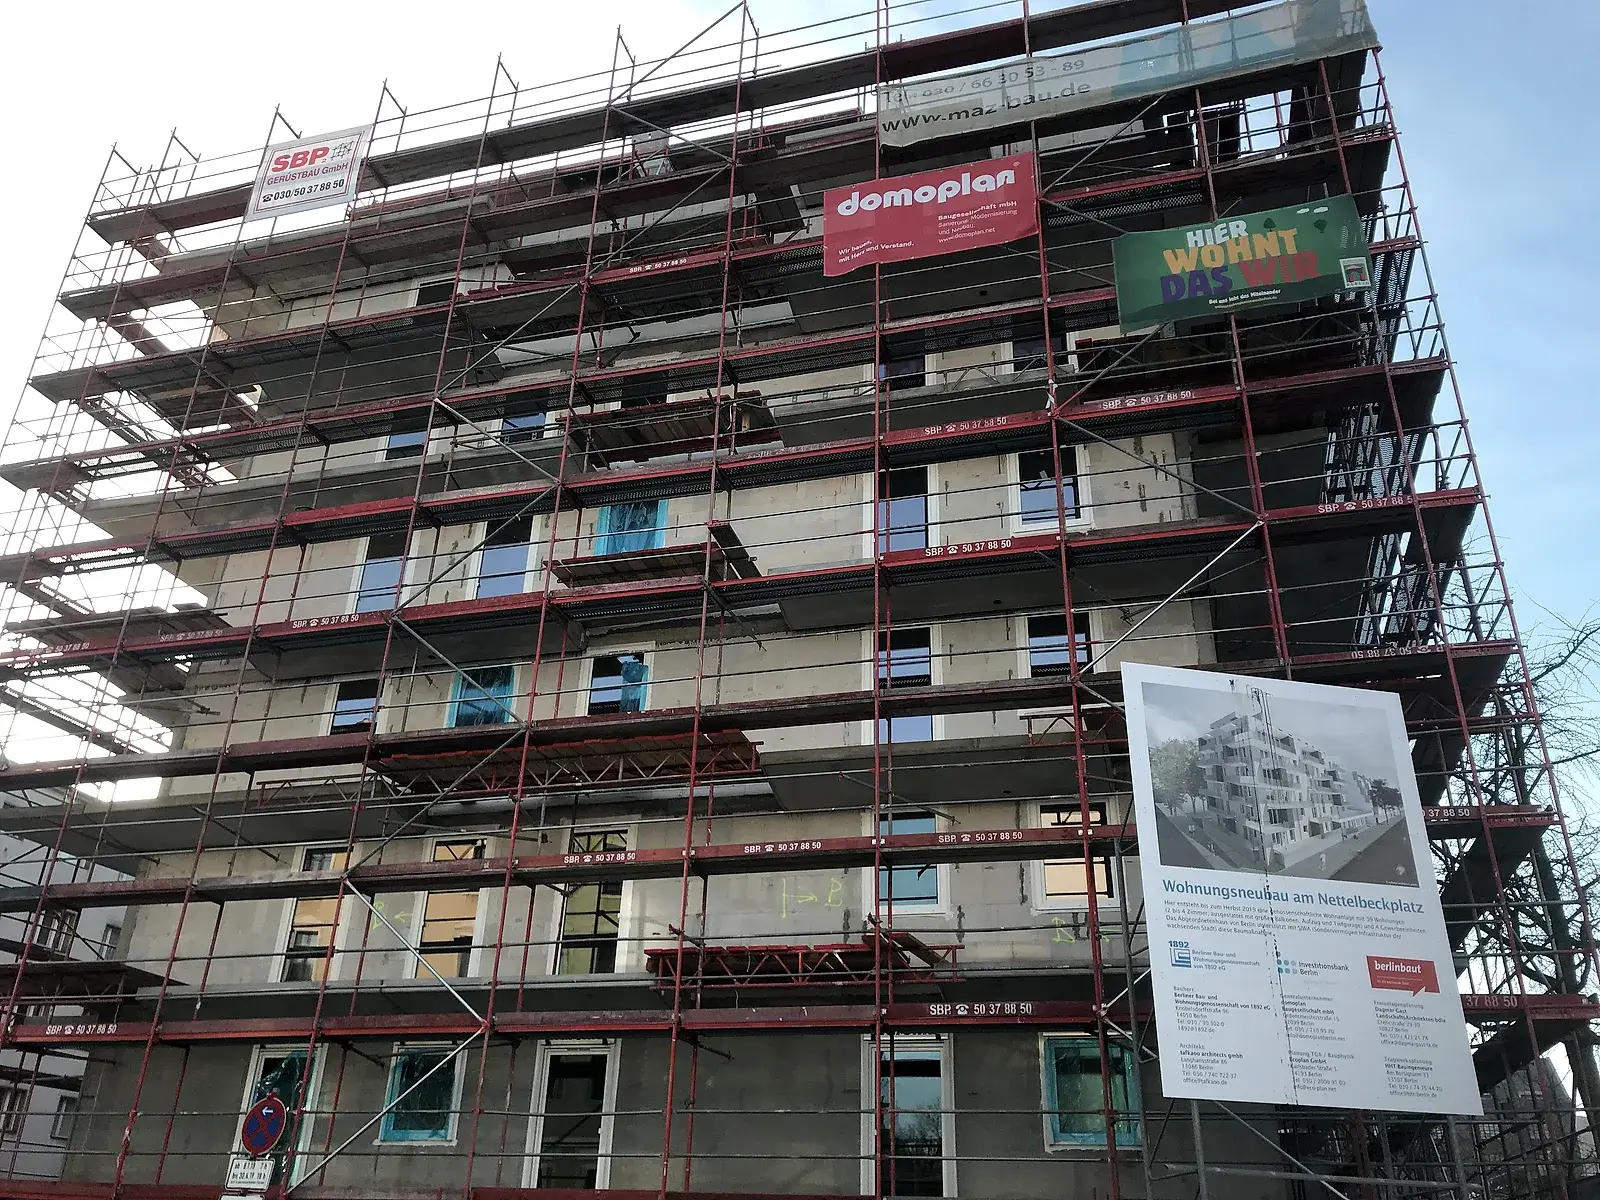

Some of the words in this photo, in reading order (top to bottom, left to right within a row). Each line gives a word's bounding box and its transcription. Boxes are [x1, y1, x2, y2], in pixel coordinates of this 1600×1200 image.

[971, 76, 993, 89] 66
[1062, 59, 1085, 72] 89
[271, 146, 330, 173] SBP
[267, 170, 320, 186] GERÜSTBAU
[321, 162, 349, 175] GmbH
[273, 187, 306, 201] 030/50
[307, 184, 319, 195] 37
[319, 181, 331, 192] 88
[333, 178, 345, 189] 50
[837, 169, 1015, 216] domoplan
[970, 209, 1018, 220] Modernisierung
[1185, 220, 1249, 248] HIER
[838, 255, 850, 263] mit
[880, 240, 915, 250] Verstand.
[1163, 228, 1298, 275] WOHNT
[1160, 265, 1233, 304] DAS
[1238, 250, 1320, 288] WIR
[1153, 394, 1164, 403] 37
[1167, 392, 1178, 401] 88
[1180, 390, 1192, 399] 50
[959, 422, 970, 431] 50
[972, 420, 982, 429] 37
[984, 419, 994, 427] 88
[996, 416, 1007, 425] 50
[1361, 499, 1373, 509] 50
[1376, 498, 1388, 507] 37
[1391, 496, 1404, 505] 88
[962, 543, 973, 553] 50
[974, 542, 986, 551] 37
[987, 541, 998, 550] 88
[1000, 539, 1012, 549] 50
[320, 618, 329, 626] 50
[330, 616, 339, 624] 37
[340, 615, 349, 623] 88
[350, 614, 359, 622] 50
[1428, 809, 1440, 817] 37
[1443, 808, 1455, 817] 88
[1458, 808, 1470, 817] 50
[975, 833, 986, 842] 50
[987, 832, 998, 841] 37
[1000, 832, 1011, 840] 88
[1012, 831, 1023, 840] 50
[778, 843, 788, 851] 50
[789, 843, 799, 851] 37
[800, 842, 810, 850] 88
[811, 841, 821, 849] 50
[595, 854, 605, 862] 50
[616, 853, 625, 861] 88
[626, 852, 636, 860] 50
[1162, 879, 1289, 902] Wohnungsneubau
[1293, 893, 1314, 904] am
[1318, 892, 1424, 914] Nettelbeckplatz
[1323, 912, 1355, 921] Wohnanlage
[1168, 940, 1190, 948] 1892
[1192, 957, 1260, 967] Wohnungsgenossenschaft
[1298, 961, 1349, 971] Investitionsbank
[1374, 960, 1421, 974] berlinbaut
[1300, 968, 1319, 976] Berlin
[1465, 995, 1479, 1007] 37
[1484, 995, 1499, 1007] 88
[1503, 995, 1518, 1007] 50
[973, 1003, 986, 1014] 50
[989, 1003, 1001, 1014] 37
[1004, 1003, 1017, 1014] 88
[1019, 1003, 1032, 1014] 50
